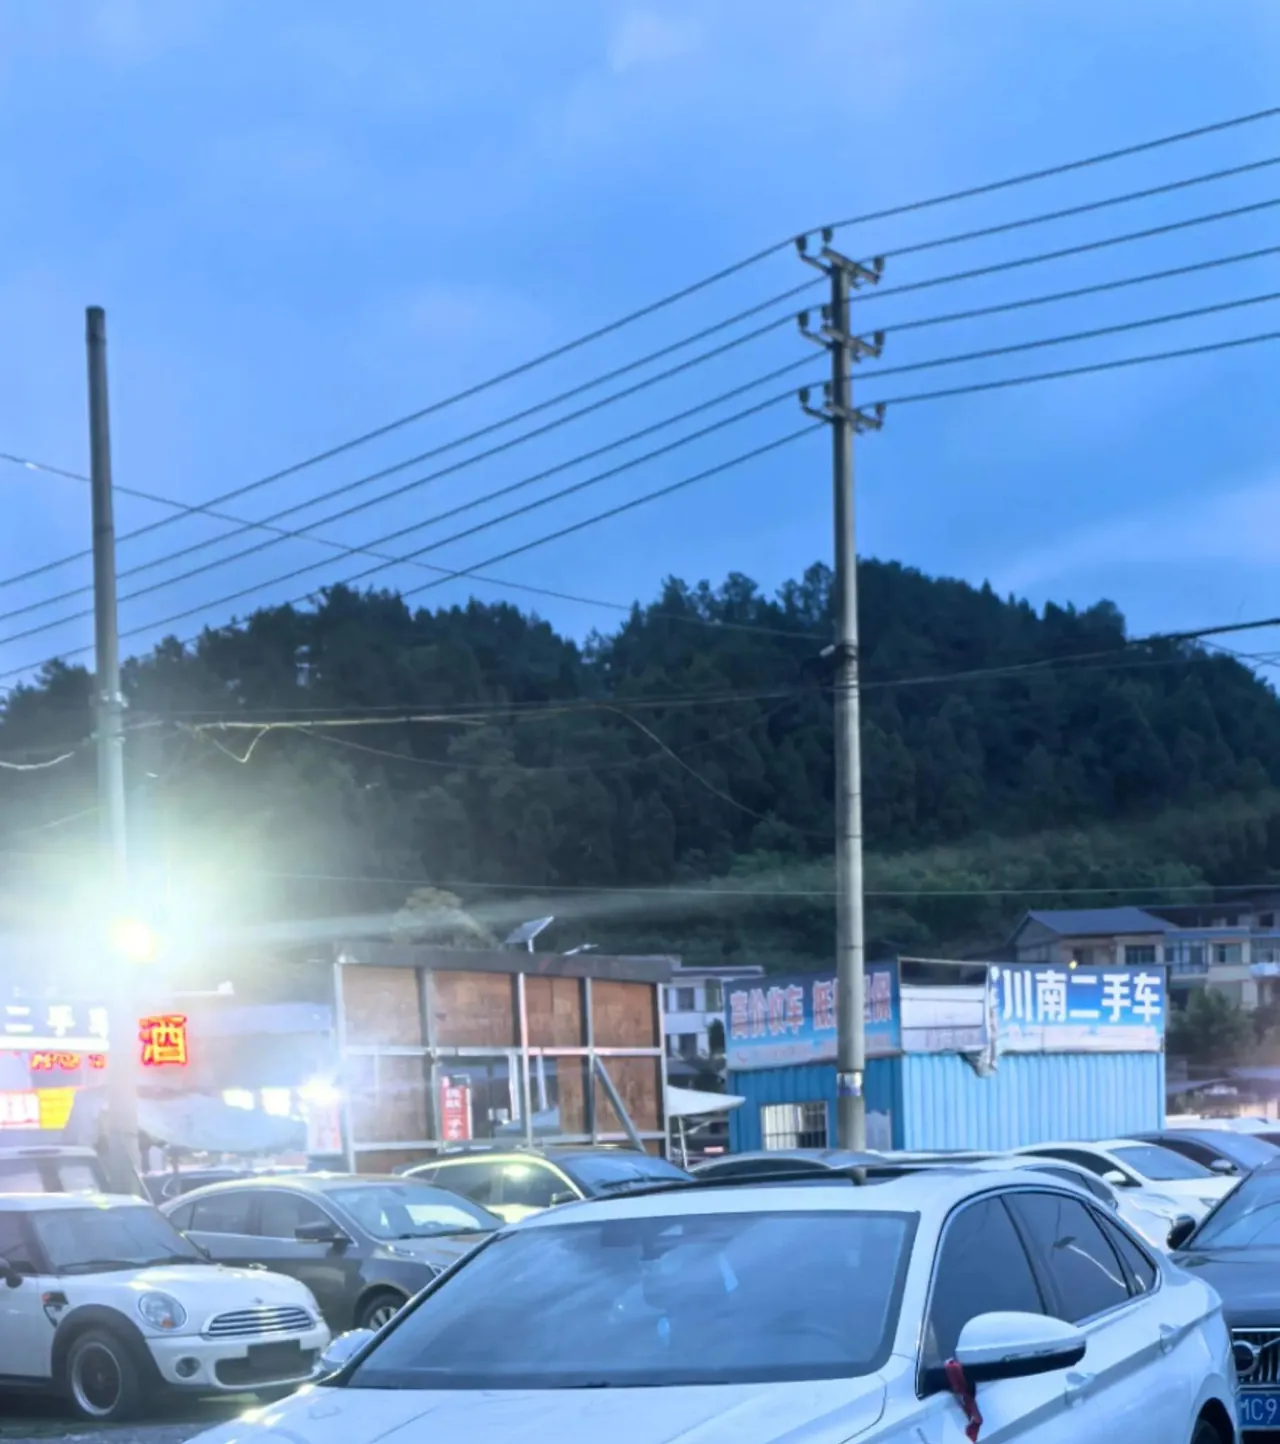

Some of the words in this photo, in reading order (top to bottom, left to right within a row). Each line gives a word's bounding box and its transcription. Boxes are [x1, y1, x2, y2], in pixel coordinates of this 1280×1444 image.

[1002, 969, 1162, 1023] 川南二手车
[139, 1015, 187, 1066] 酒
